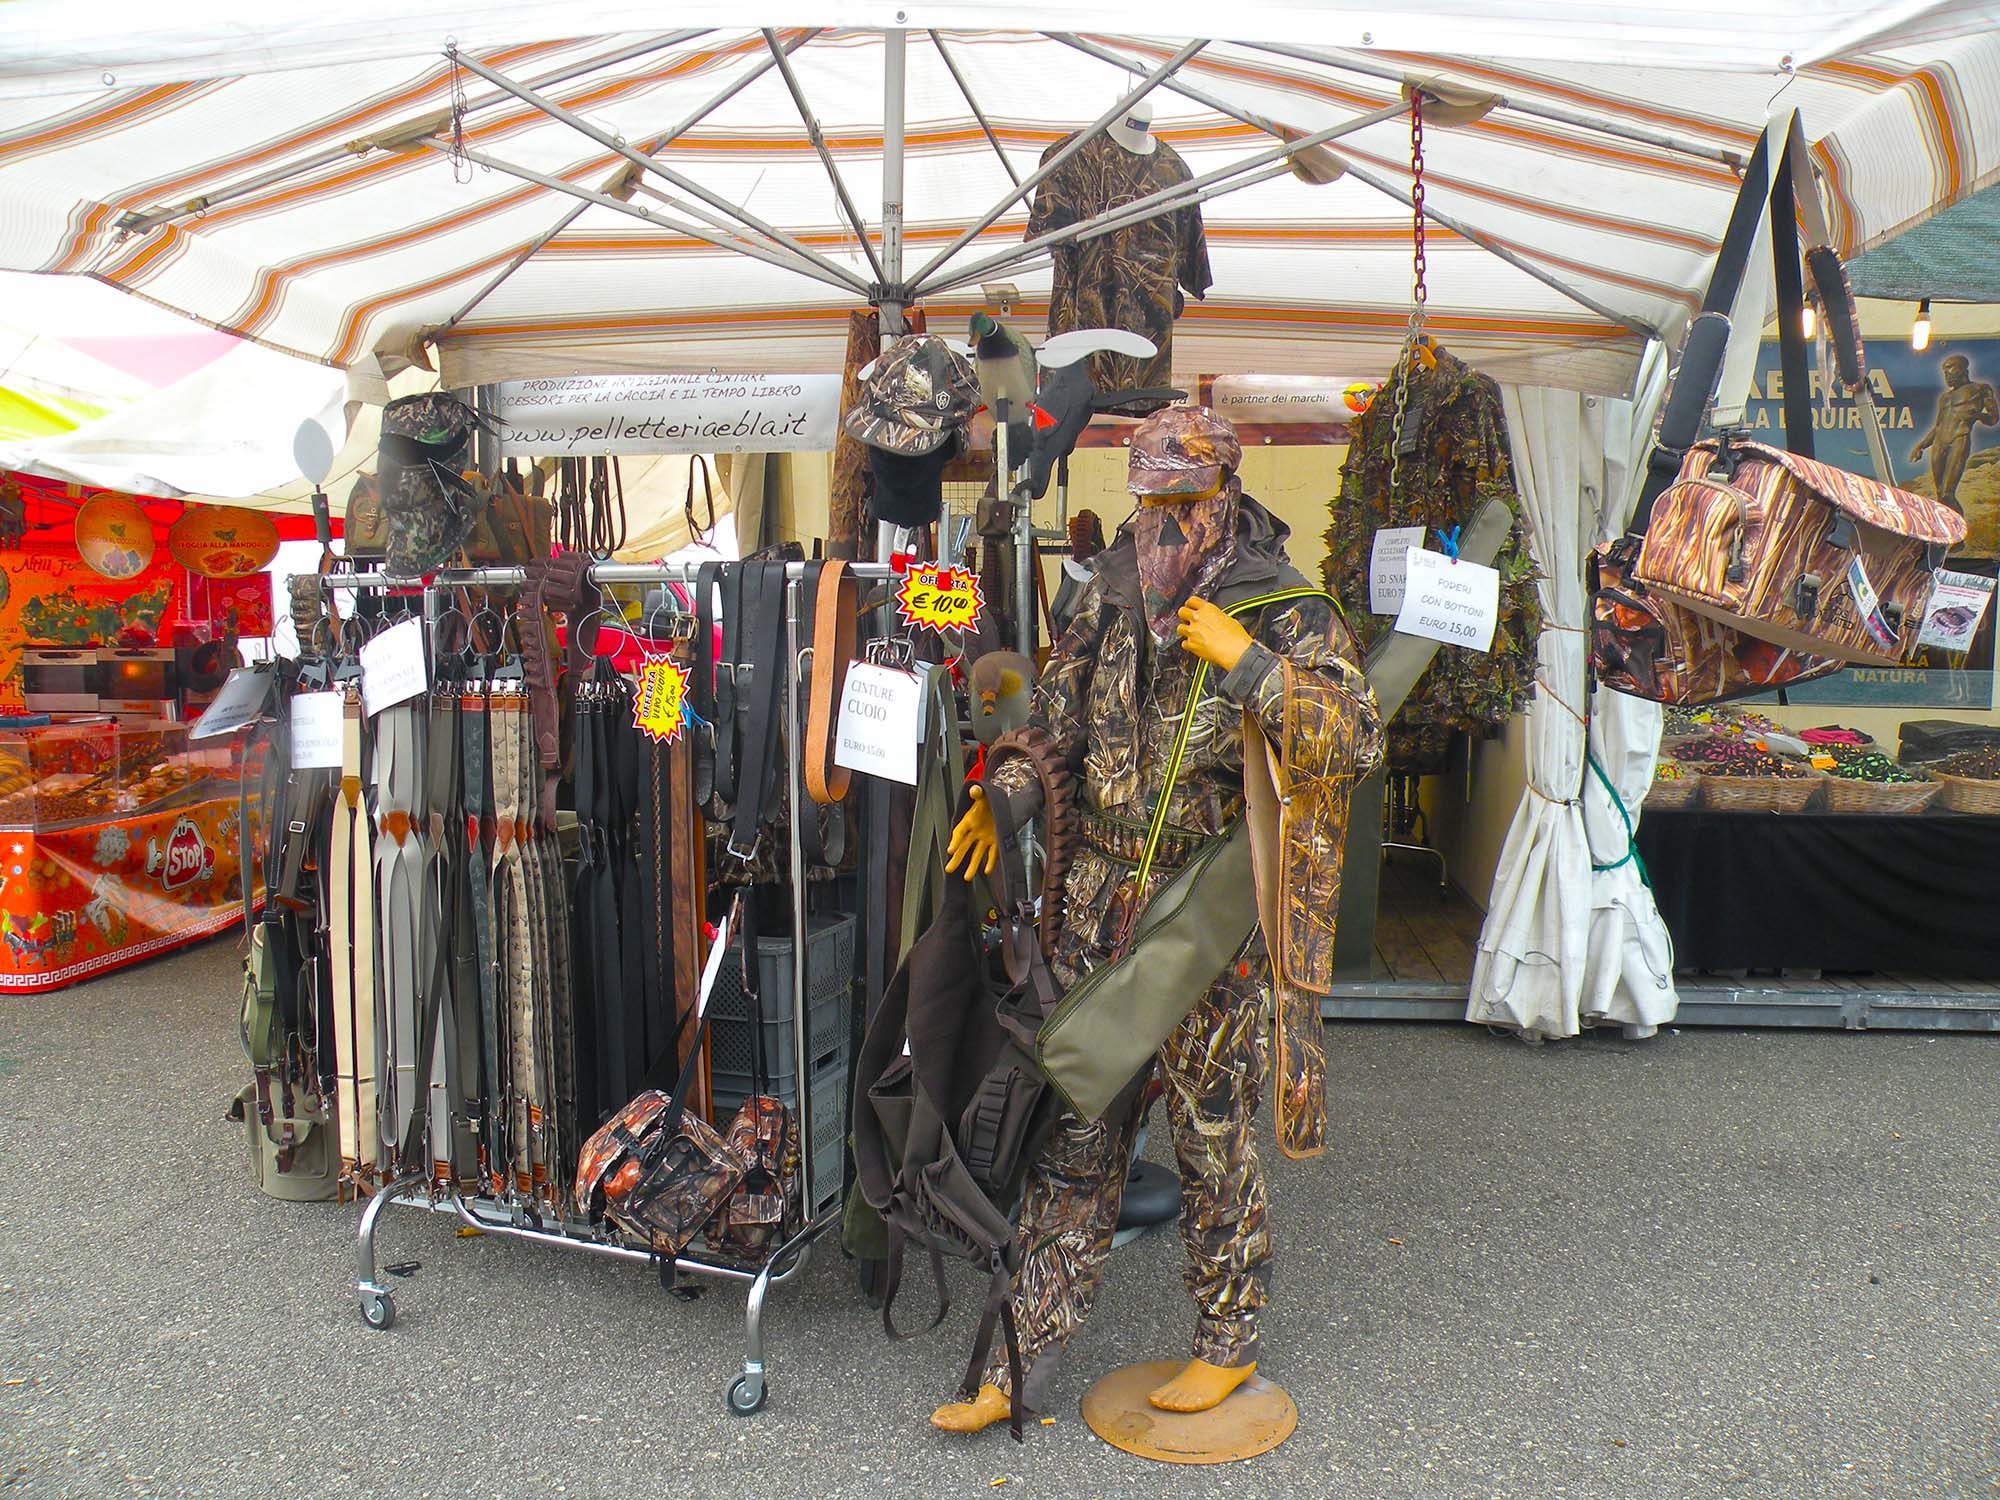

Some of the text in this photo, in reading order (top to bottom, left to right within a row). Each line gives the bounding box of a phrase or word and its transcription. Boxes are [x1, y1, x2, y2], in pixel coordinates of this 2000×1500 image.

[568, 392, 588, 404] PER
[594, 391, 609, 403] LA
[614, 389, 665, 402] CACCIA
[669, 389, 679, 400] E
[682, 388, 698, 400] IL
[703, 386, 747, 399] TEMPO
[751, 384, 802, 398] LIBERO
[1221, 393, 1329, 405] è partner dei marchi:
[1377, 588, 1397, 599] EURO
[1438, 578, 1472, 595] FODERI
[912, 592, 930, 609] €
[1420, 595, 1485, 619] CON BOTTONI
[1419, 616, 1477, 638] EURO 15,00
[1852, 669, 1928, 684] NATURA
[642, 671, 656, 718] OFFERTA
[850, 679, 895, 702] CINTURE
[652, 697, 662, 719] VERO
[847, 698, 887, 721] CUOIO
[843, 738, 866, 753] EURO
[168, 843, 201, 876] STOP
